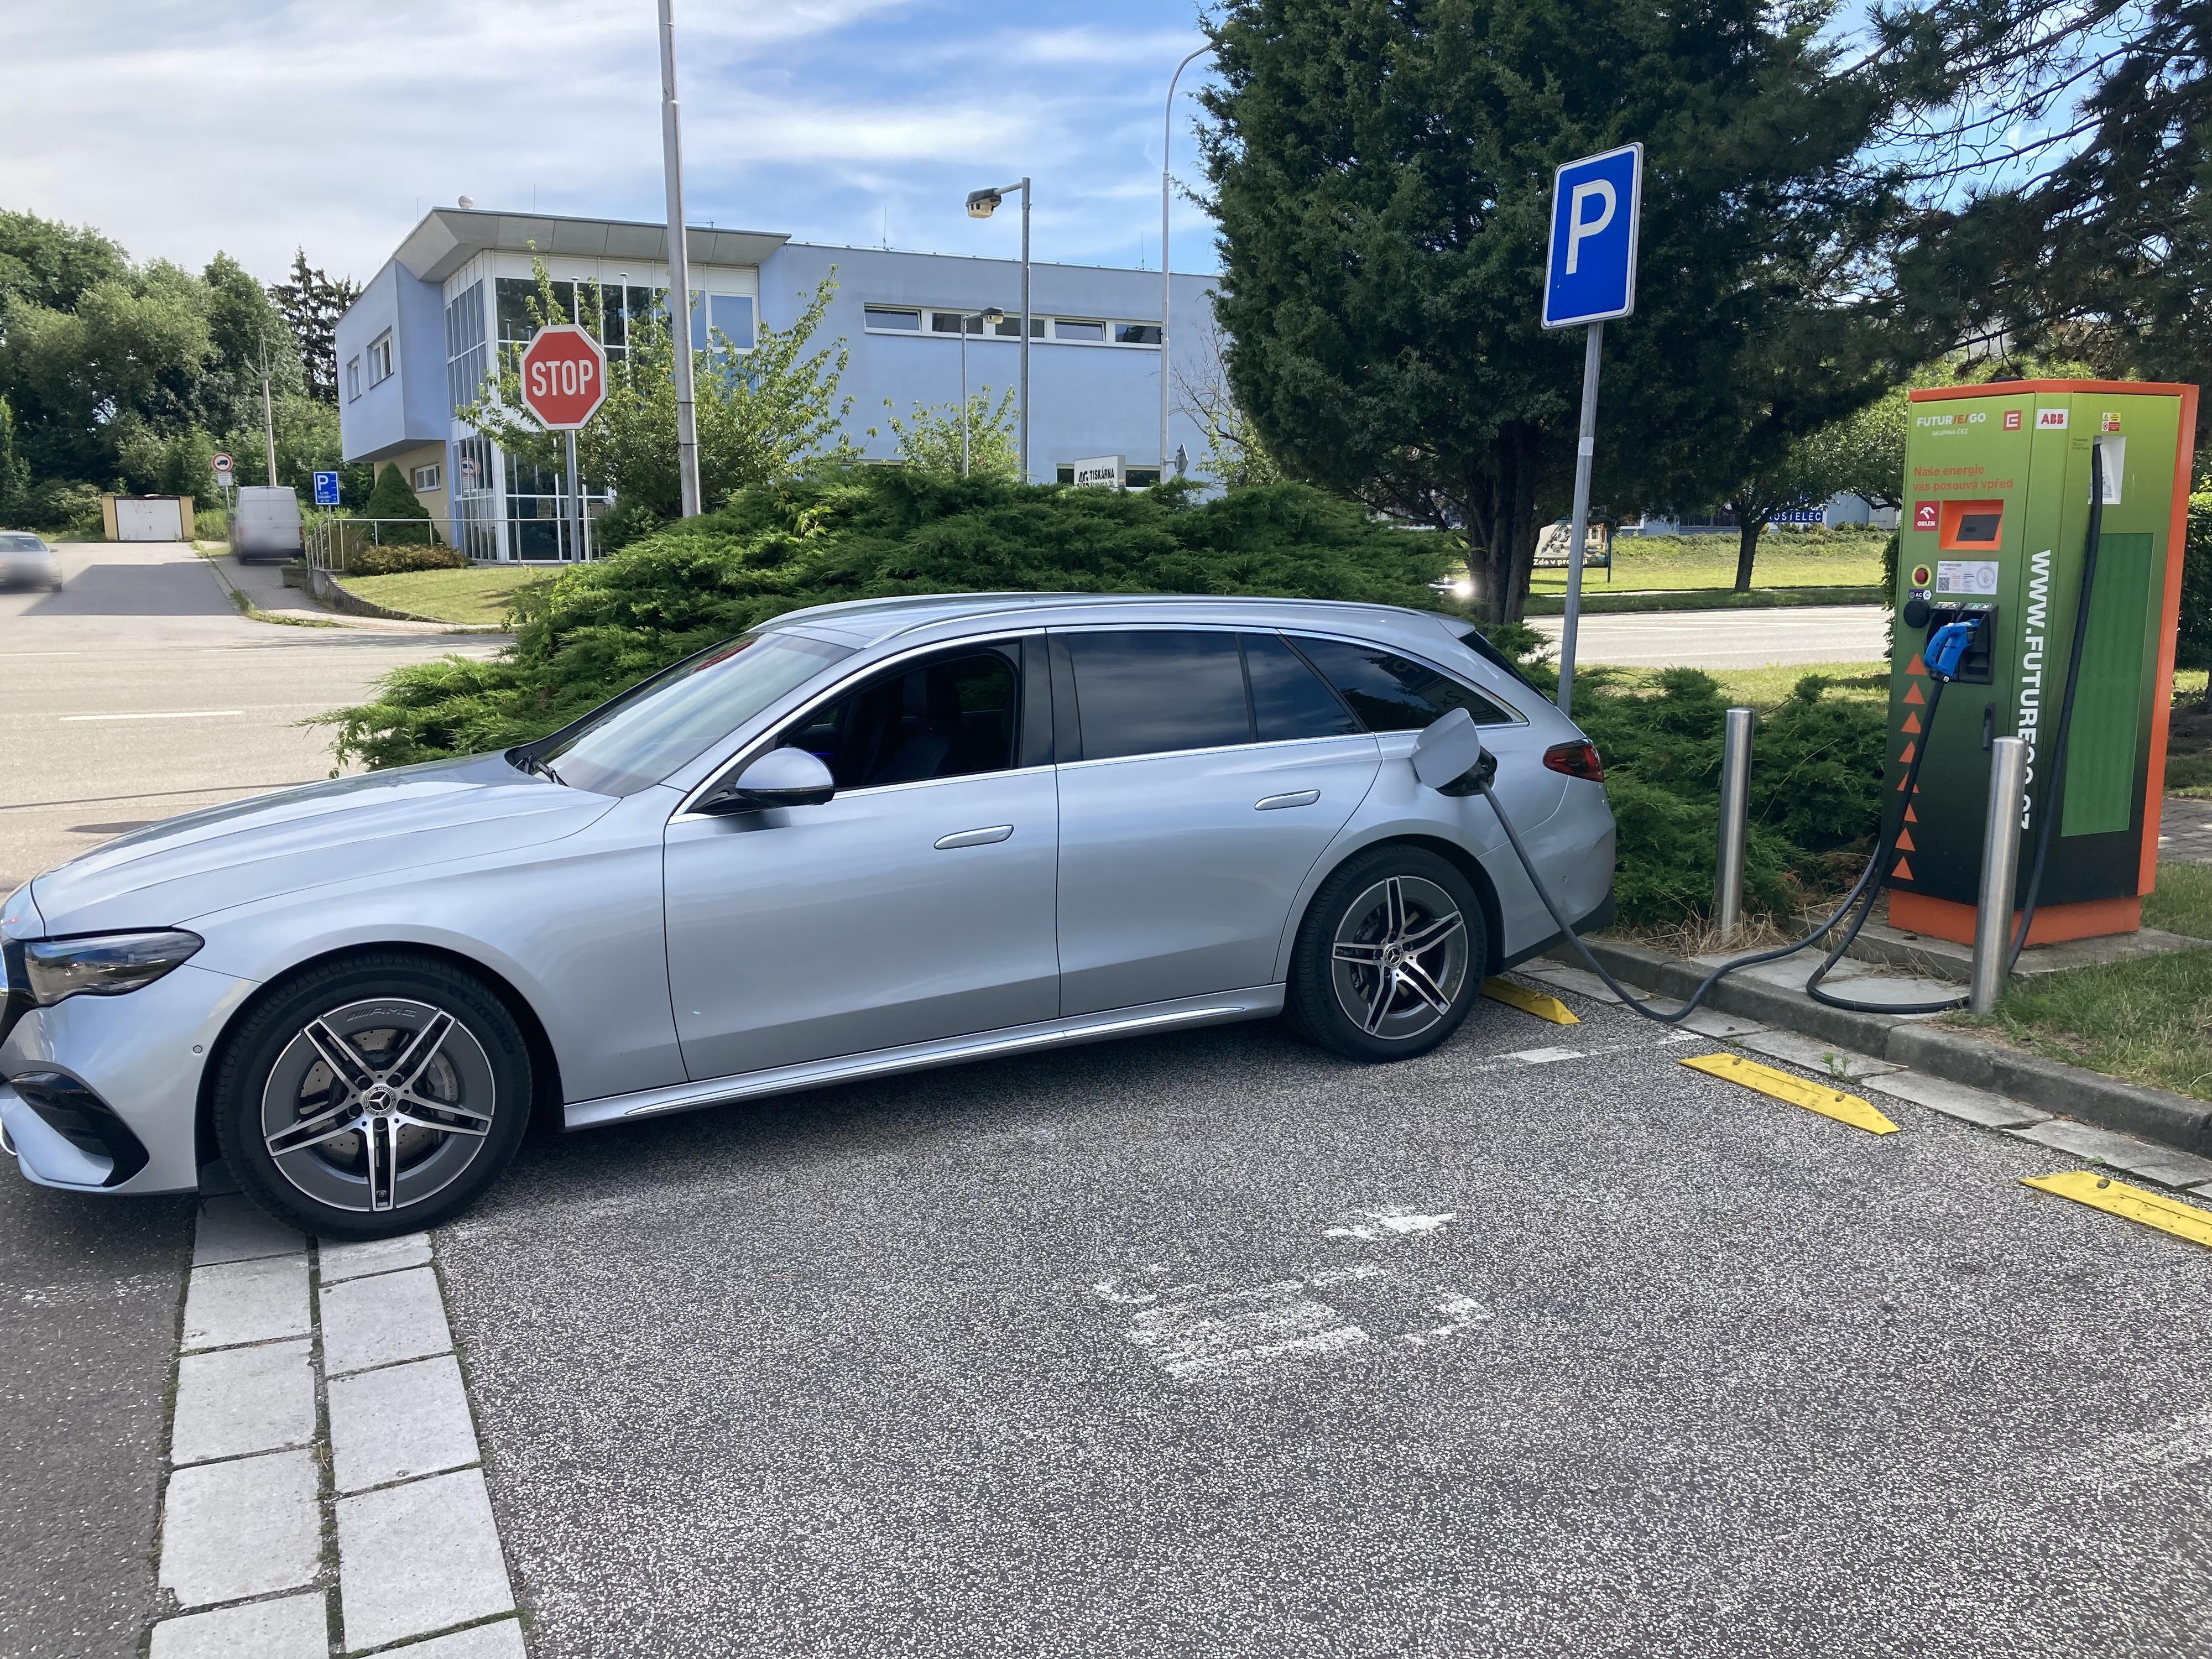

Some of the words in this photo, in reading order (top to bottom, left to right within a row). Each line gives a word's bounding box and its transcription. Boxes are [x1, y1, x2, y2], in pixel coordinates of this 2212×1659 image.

[1566, 179, 1616, 275] P
[531, 359, 593, 397] STOP
[2041, 414, 2064, 425] ABB
[1089, 466, 1114, 481] TISKÁRNA
[1914, 466, 1940, 477] Naše
[1943, 465, 1985, 476] energie
[317, 475, 328, 491] P
[1913, 482, 1930, 492] vás
[1933, 480, 1978, 493] posouvá
[1981, 478, 2013, 491] vpřed
[1768, 512, 1821, 521] OSTELEC
